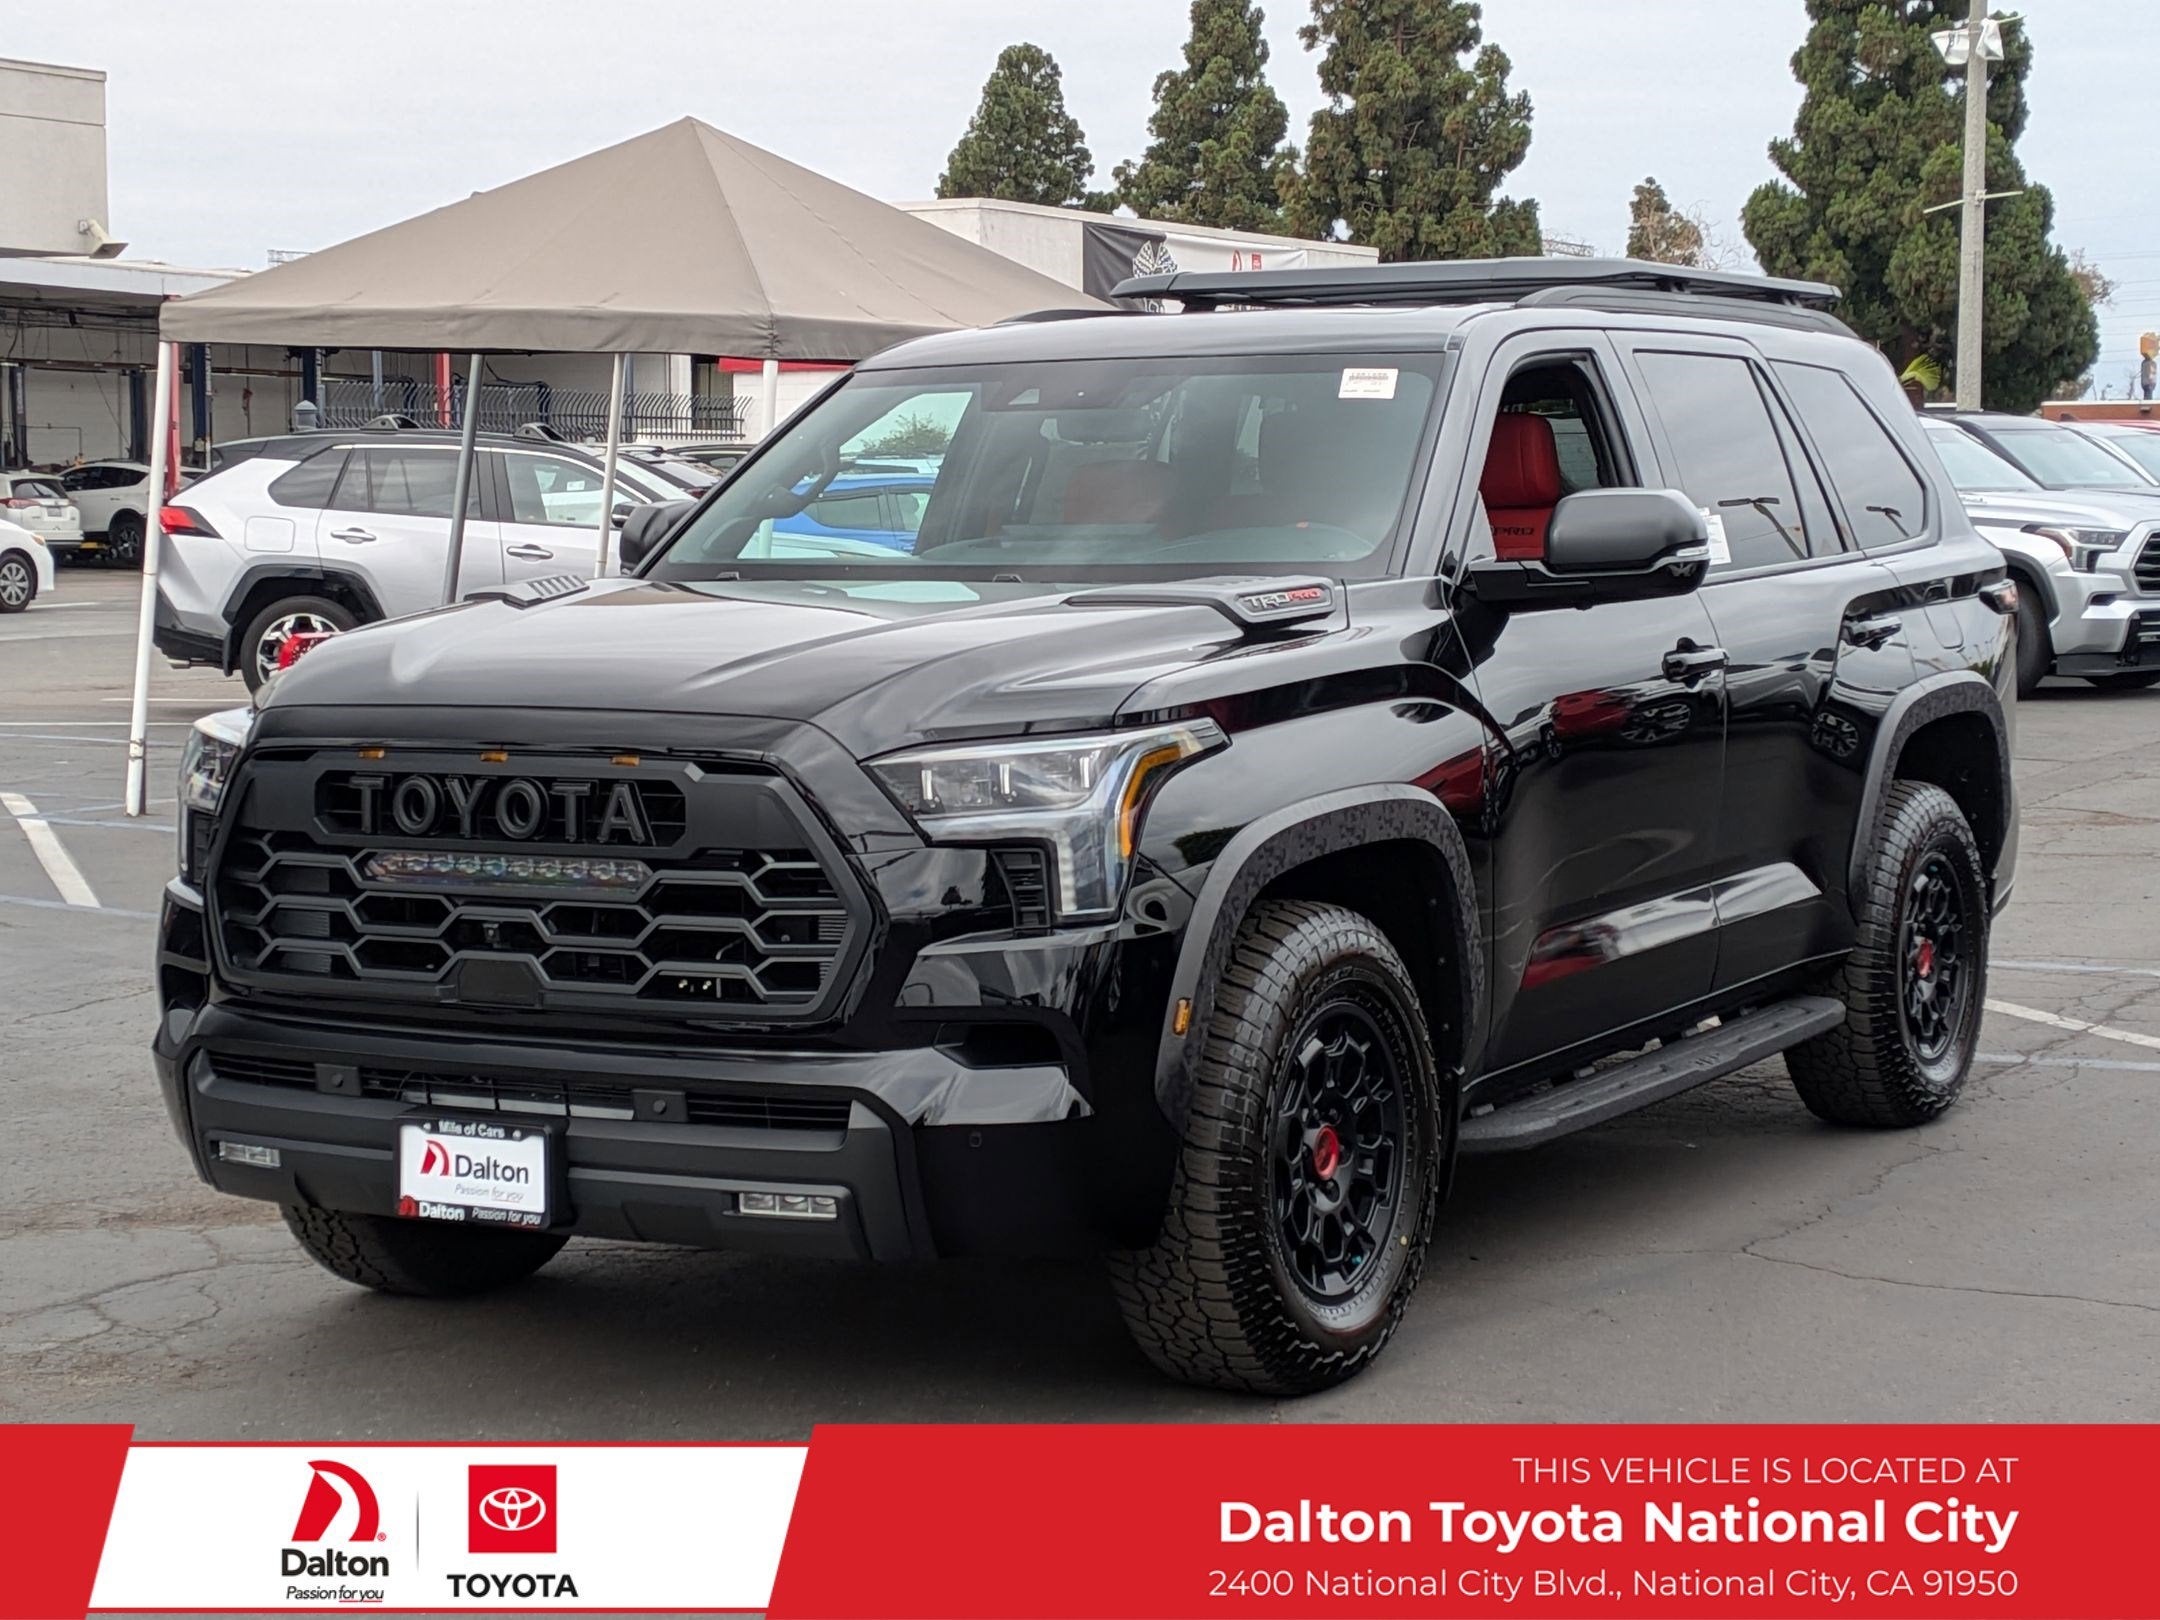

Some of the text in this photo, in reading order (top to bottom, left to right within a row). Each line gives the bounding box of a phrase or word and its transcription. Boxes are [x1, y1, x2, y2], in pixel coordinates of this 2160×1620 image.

[350, 774, 648, 844] TOYOTA
[438, 1120, 506, 1139] Mile of Cars
[454, 1153, 529, 1185] Dalton
[454, 1182, 490, 1198] Passion
[491, 1186, 506, 1201] for
[418, 1201, 542, 1227] Dalton Passion for you
